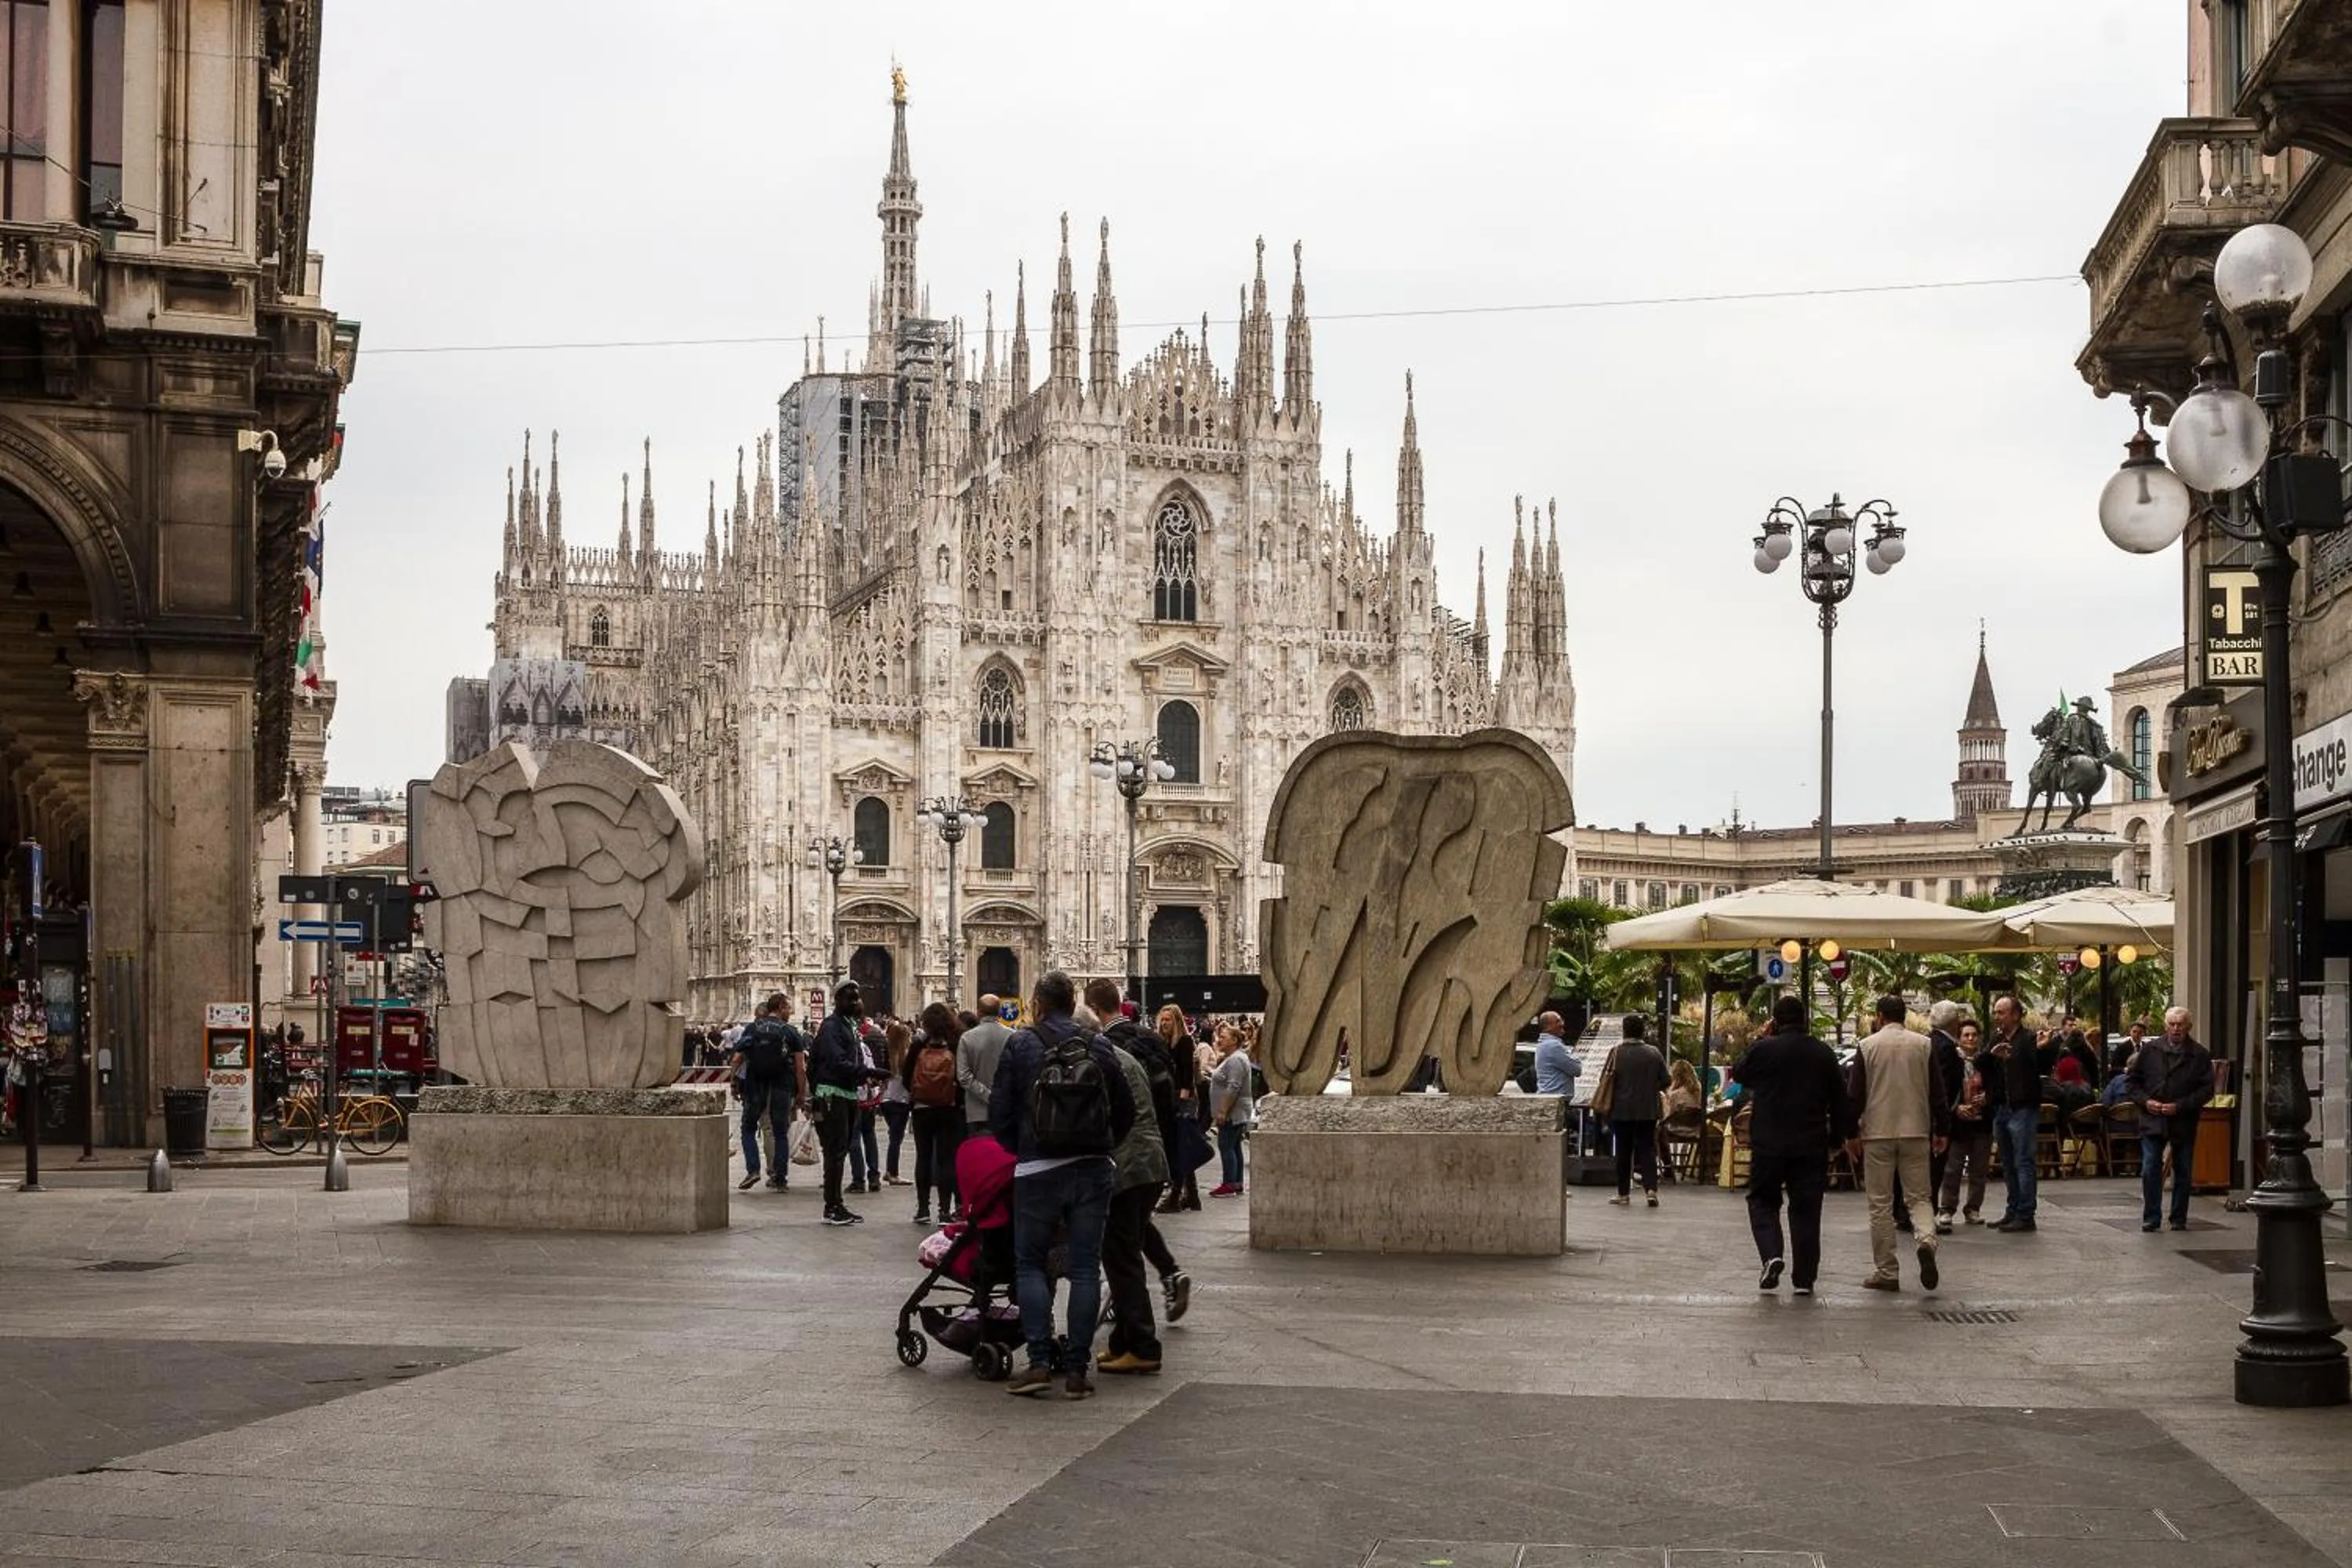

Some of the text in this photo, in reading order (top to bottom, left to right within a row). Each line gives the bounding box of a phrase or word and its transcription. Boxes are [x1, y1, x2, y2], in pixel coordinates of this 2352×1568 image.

[2209, 572, 2259, 634] T
[2208, 637, 2262, 649] Tabacchi
[2212, 657, 2258, 675] BAR
